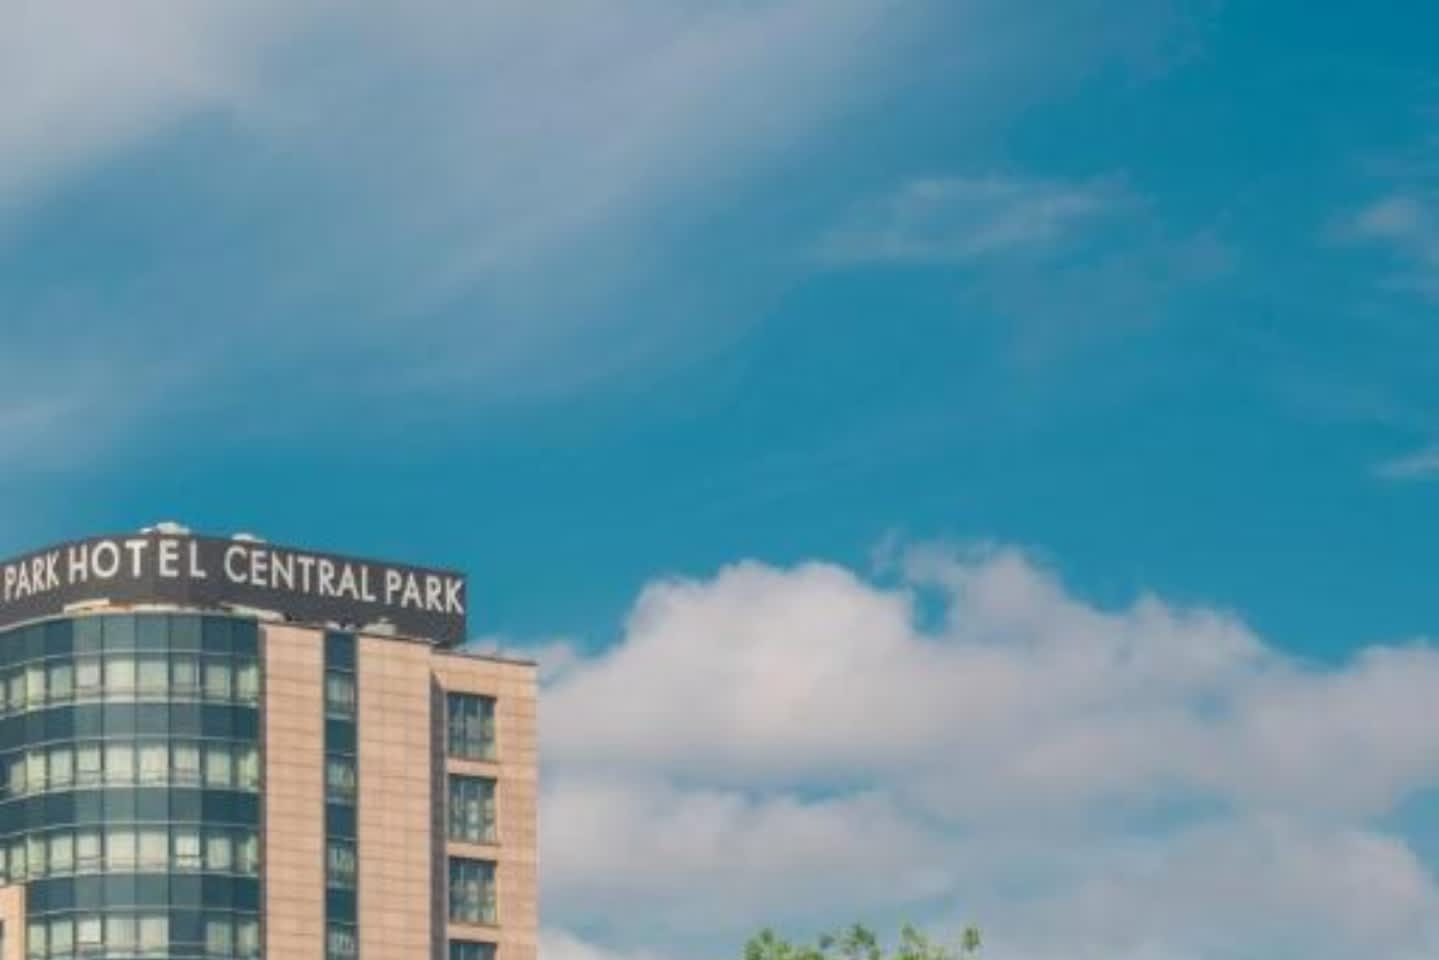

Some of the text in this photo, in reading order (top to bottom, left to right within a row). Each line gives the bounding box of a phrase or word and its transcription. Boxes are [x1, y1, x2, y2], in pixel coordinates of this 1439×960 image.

[4, 550, 60, 600] PARK
[68, 540, 206, 583] HOTEL
[224, 546, 375, 601] CENTRAL
[385, 573, 465, 615] PARK
